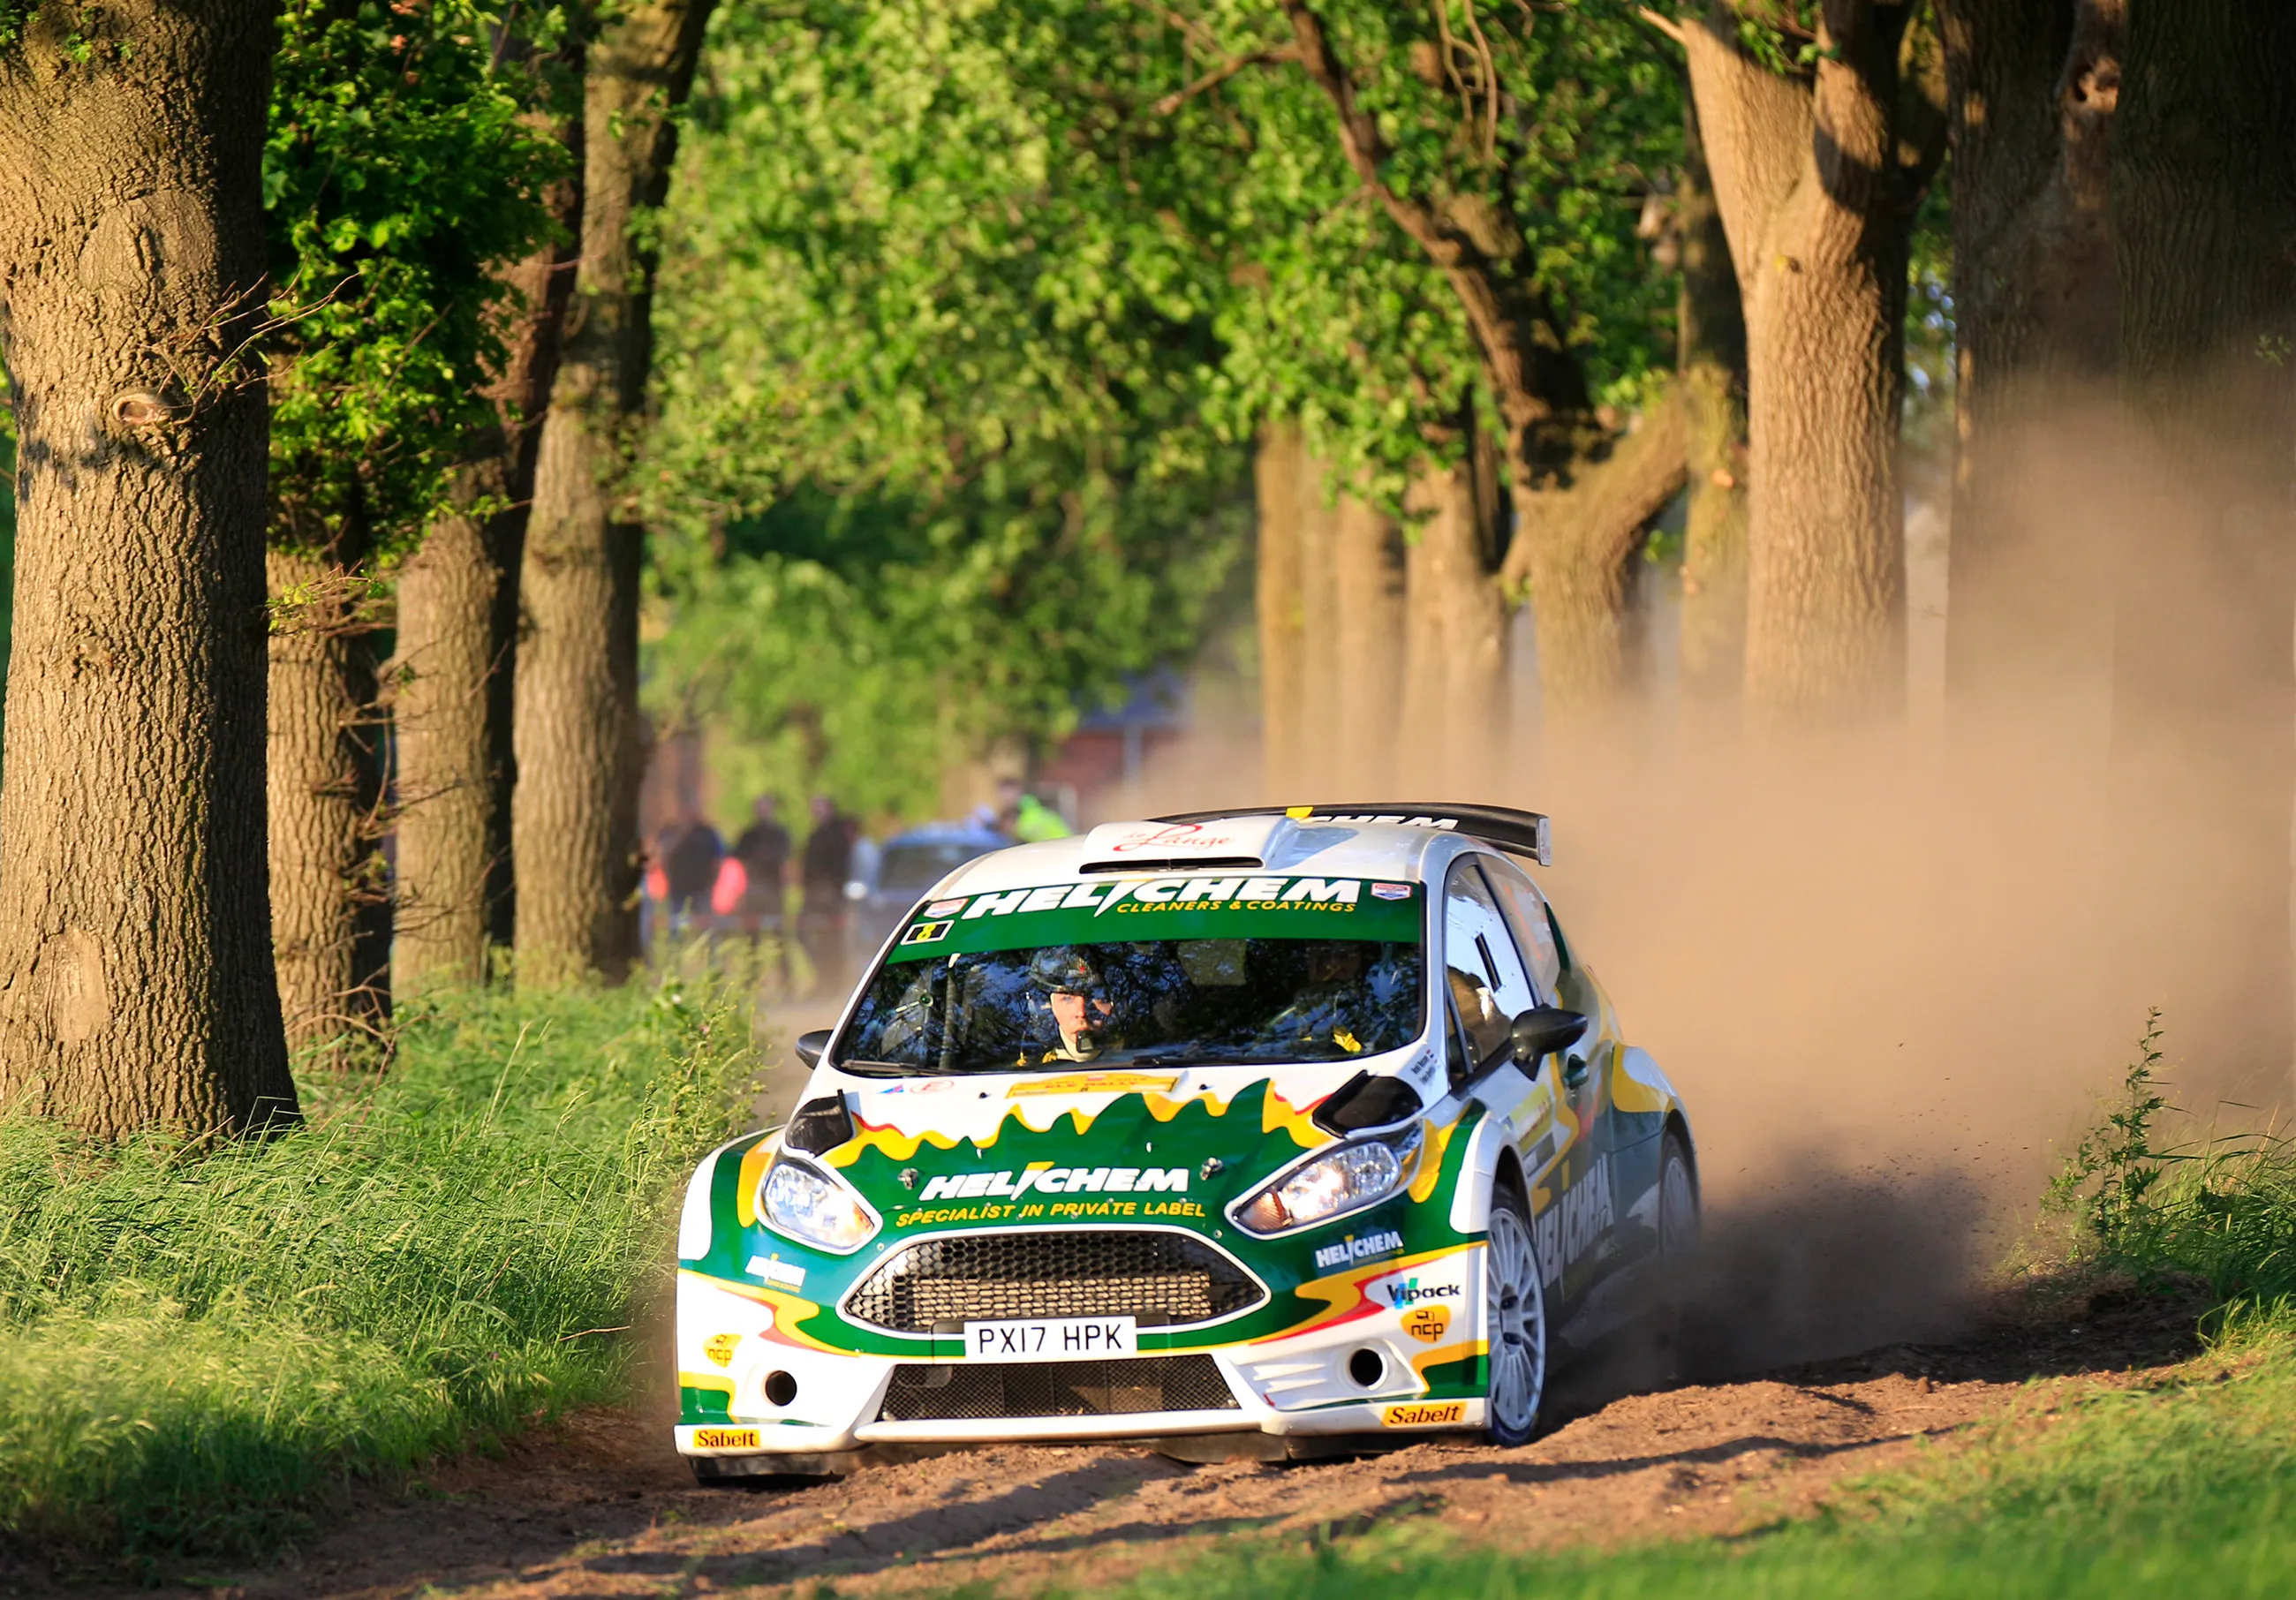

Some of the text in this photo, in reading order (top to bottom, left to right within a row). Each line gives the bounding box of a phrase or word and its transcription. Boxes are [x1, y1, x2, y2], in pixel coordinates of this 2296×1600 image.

[1113, 824, 1235, 851] Lange
[1116, 901, 1356, 913] CLEANERS & COATINGS
[917, 923, 936, 941] 8
[895, 1202, 1206, 1228] SPECIALIST IN PRIVATE LABEL
[1387, 1280, 1461, 1307] Vipack
[978, 1324, 1122, 1354] PX17 HPK
[1411, 1323, 1444, 1341] ncp
[707, 1348, 731, 1367] ncp
[1389, 1406, 1460, 1424] Sabelt
[699, 1430, 756, 1447] Sabelt
